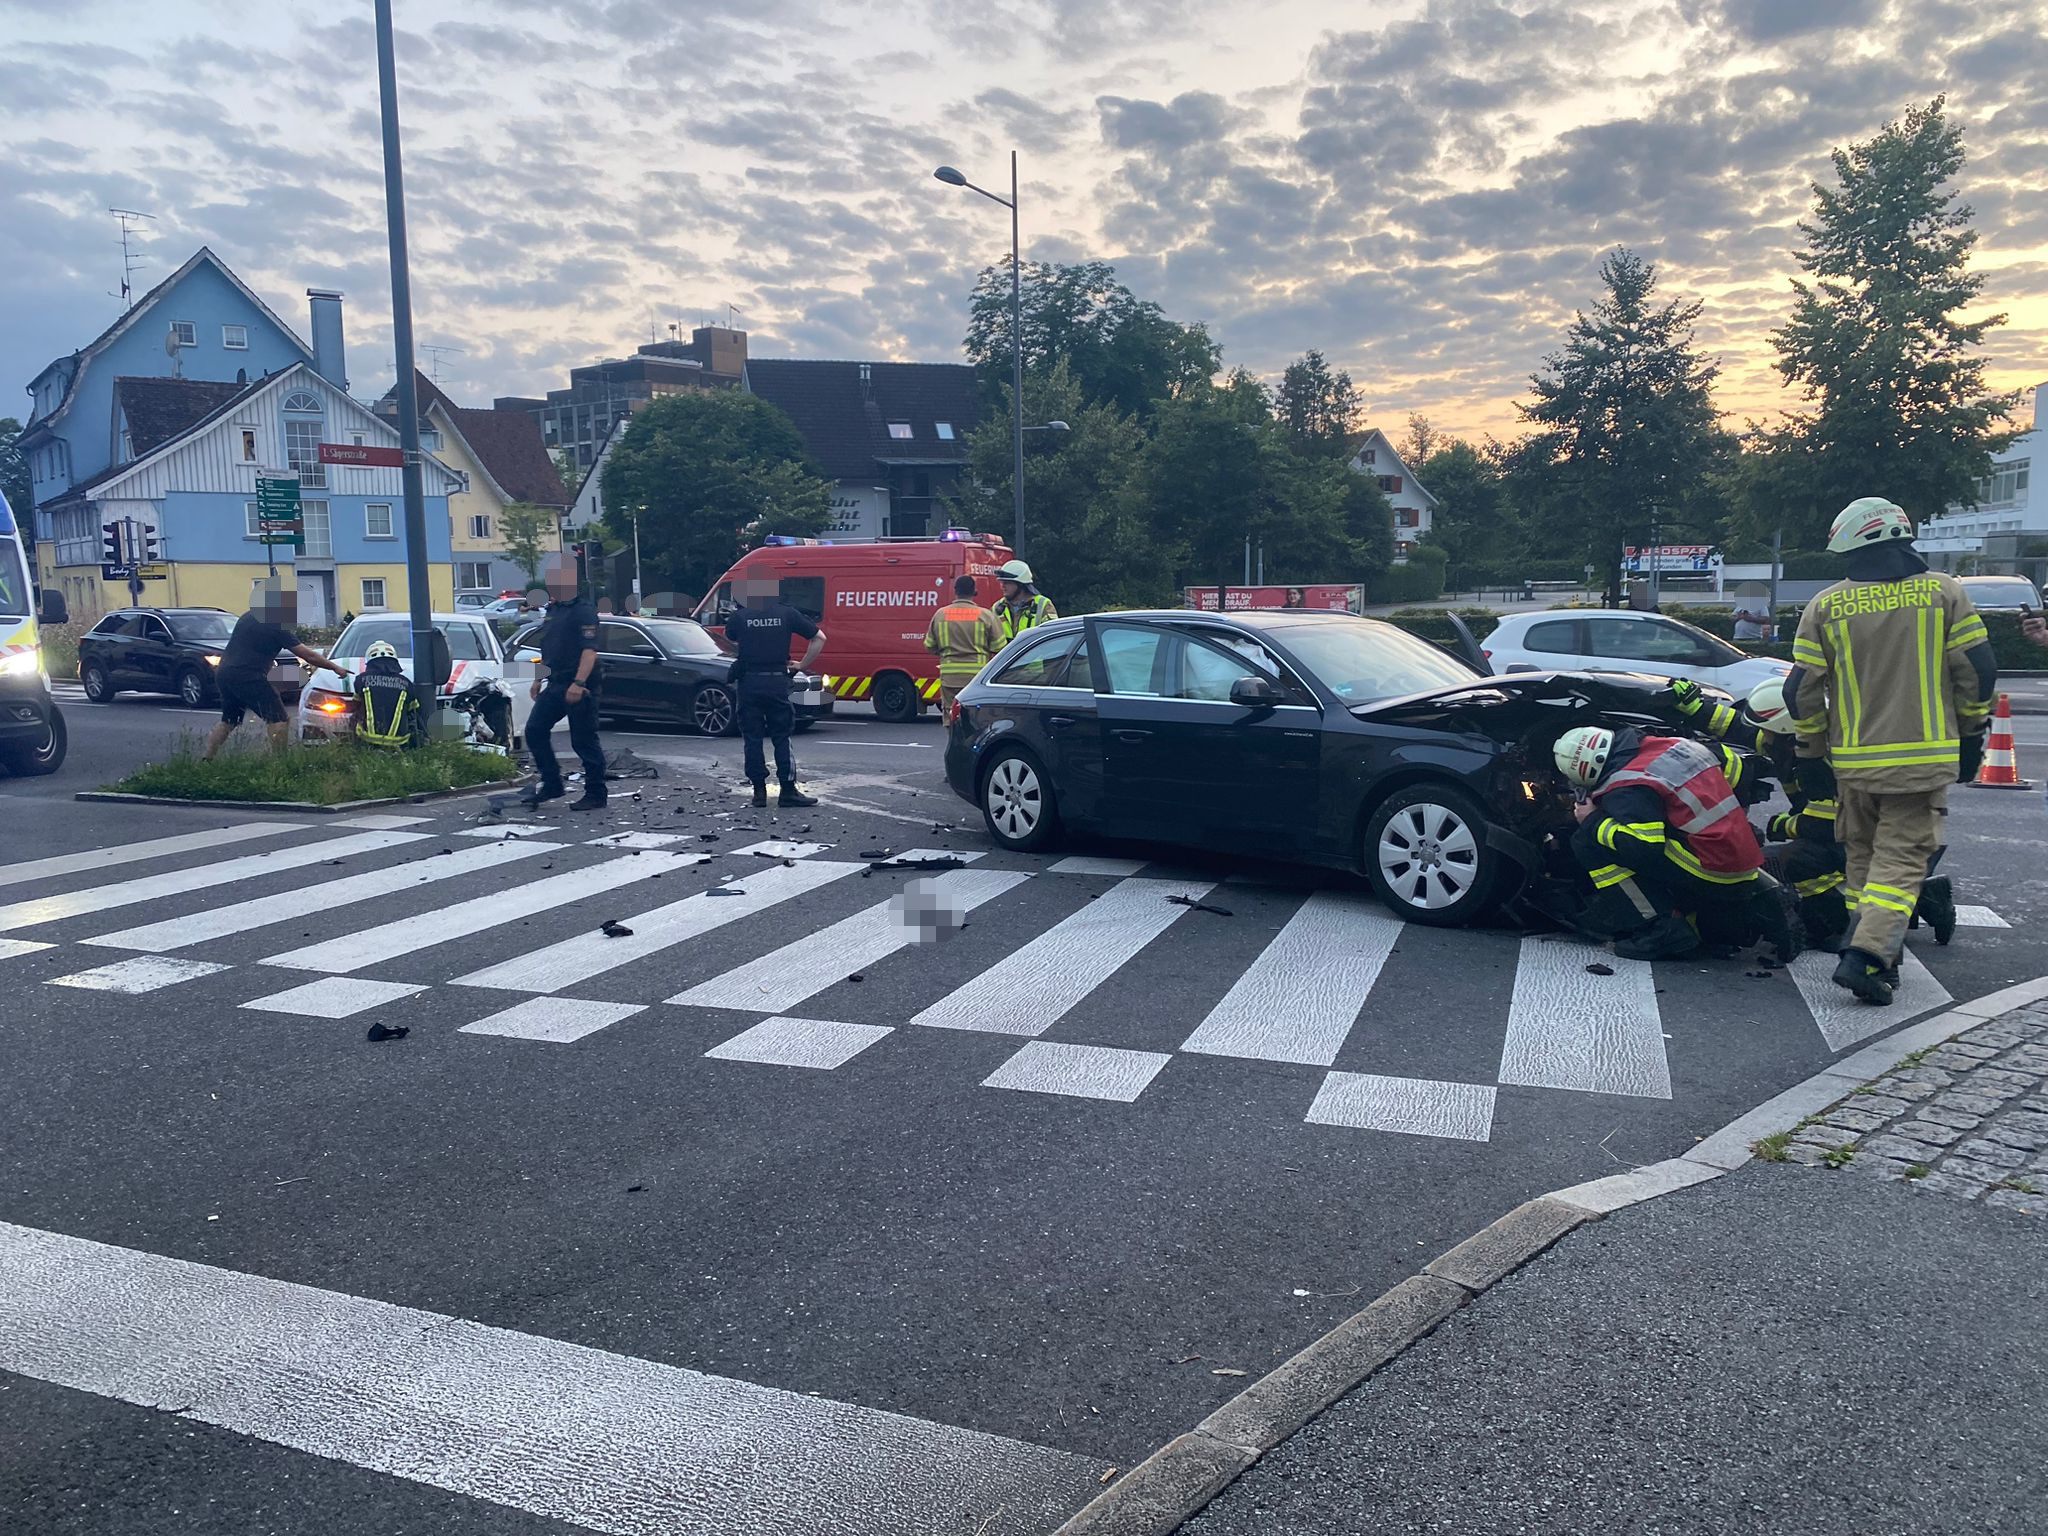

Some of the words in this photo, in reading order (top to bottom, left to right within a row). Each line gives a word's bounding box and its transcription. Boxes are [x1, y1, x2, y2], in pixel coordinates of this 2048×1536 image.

[829, 497, 860, 507] ahr
[827, 521, 861, 532] ahr
[836, 591, 938, 607] FEUERWEHR
[1820, 578, 1942, 609] FEUERWEHR
[1830, 592, 1932, 619] DORNBIRN
[747, 618, 781, 627] POLIZEI
[362, 675, 409, 686] FEUERWEHR
[365, 679, 406, 690] DORNBIRN
[1571, 735, 1587, 770] FEUERWEHR
